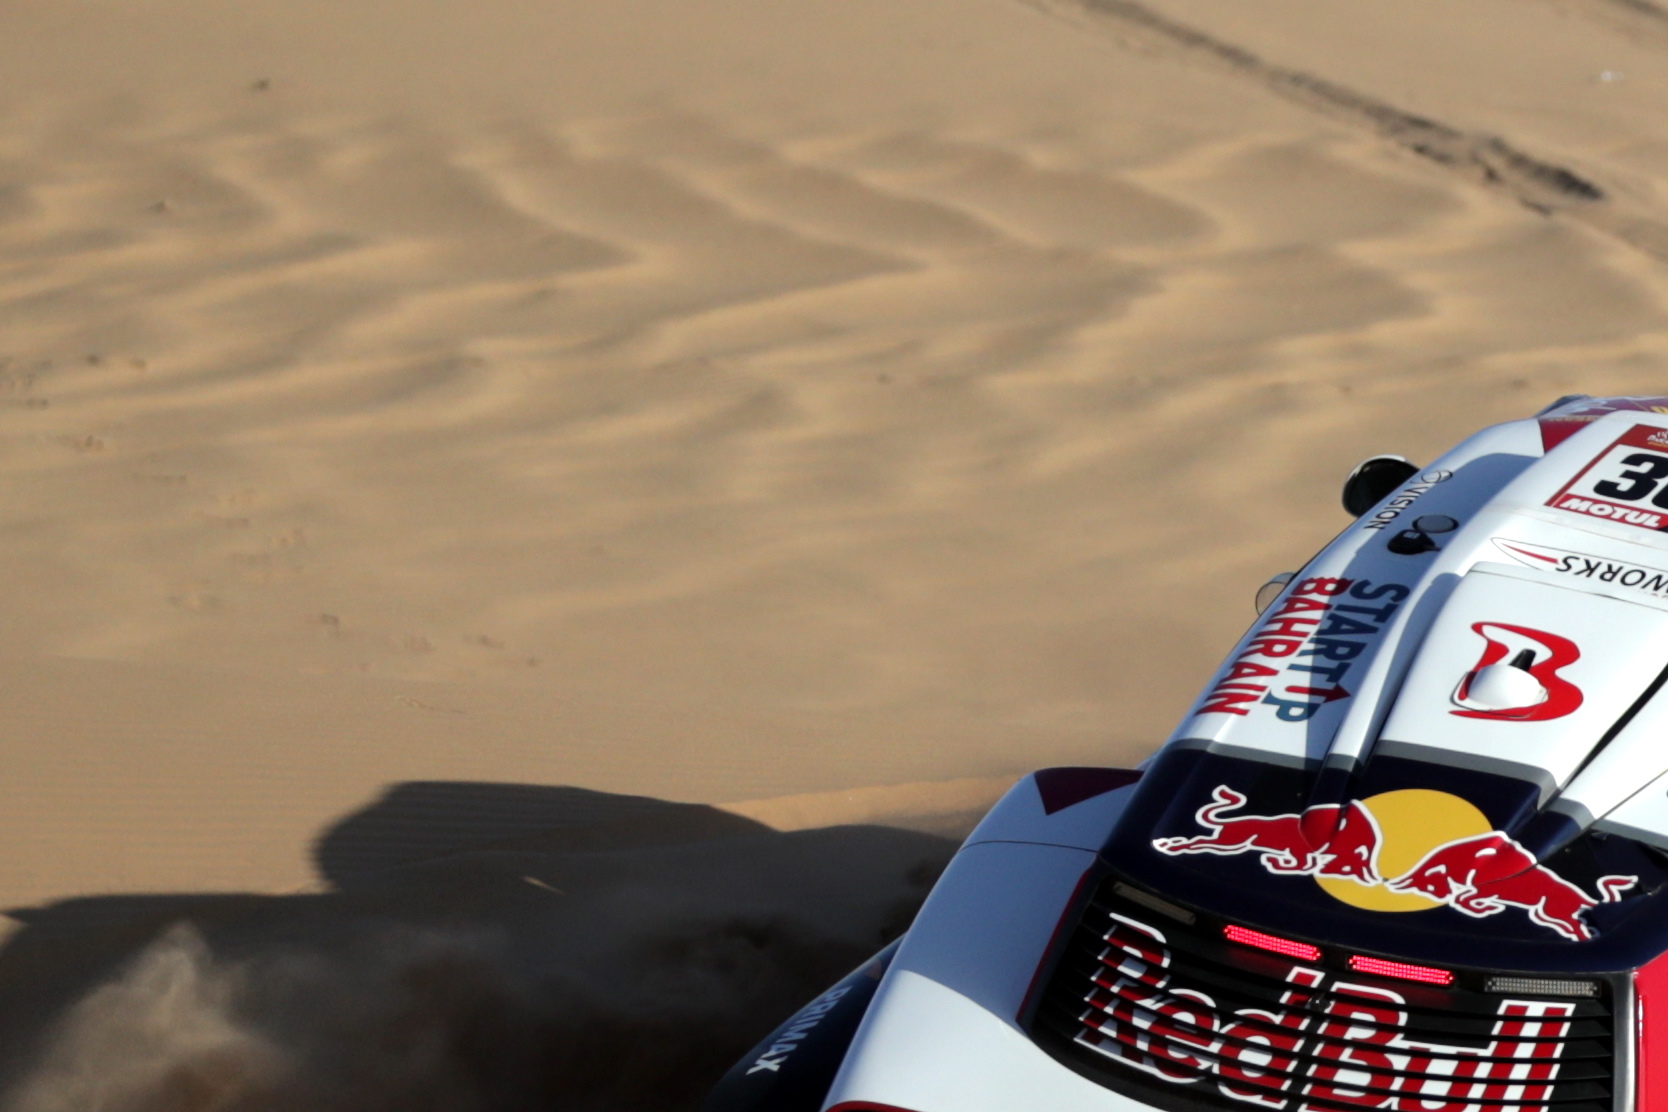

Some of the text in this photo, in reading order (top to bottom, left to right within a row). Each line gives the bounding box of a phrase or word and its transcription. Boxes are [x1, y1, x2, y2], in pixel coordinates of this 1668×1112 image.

[1363, 482, 1436, 530] VISION
[1560, 497, 1663, 529] MOTUL
[1193, 577, 1356, 717] BAHRAIN
[746, 985, 853, 1076] PRIMAX
